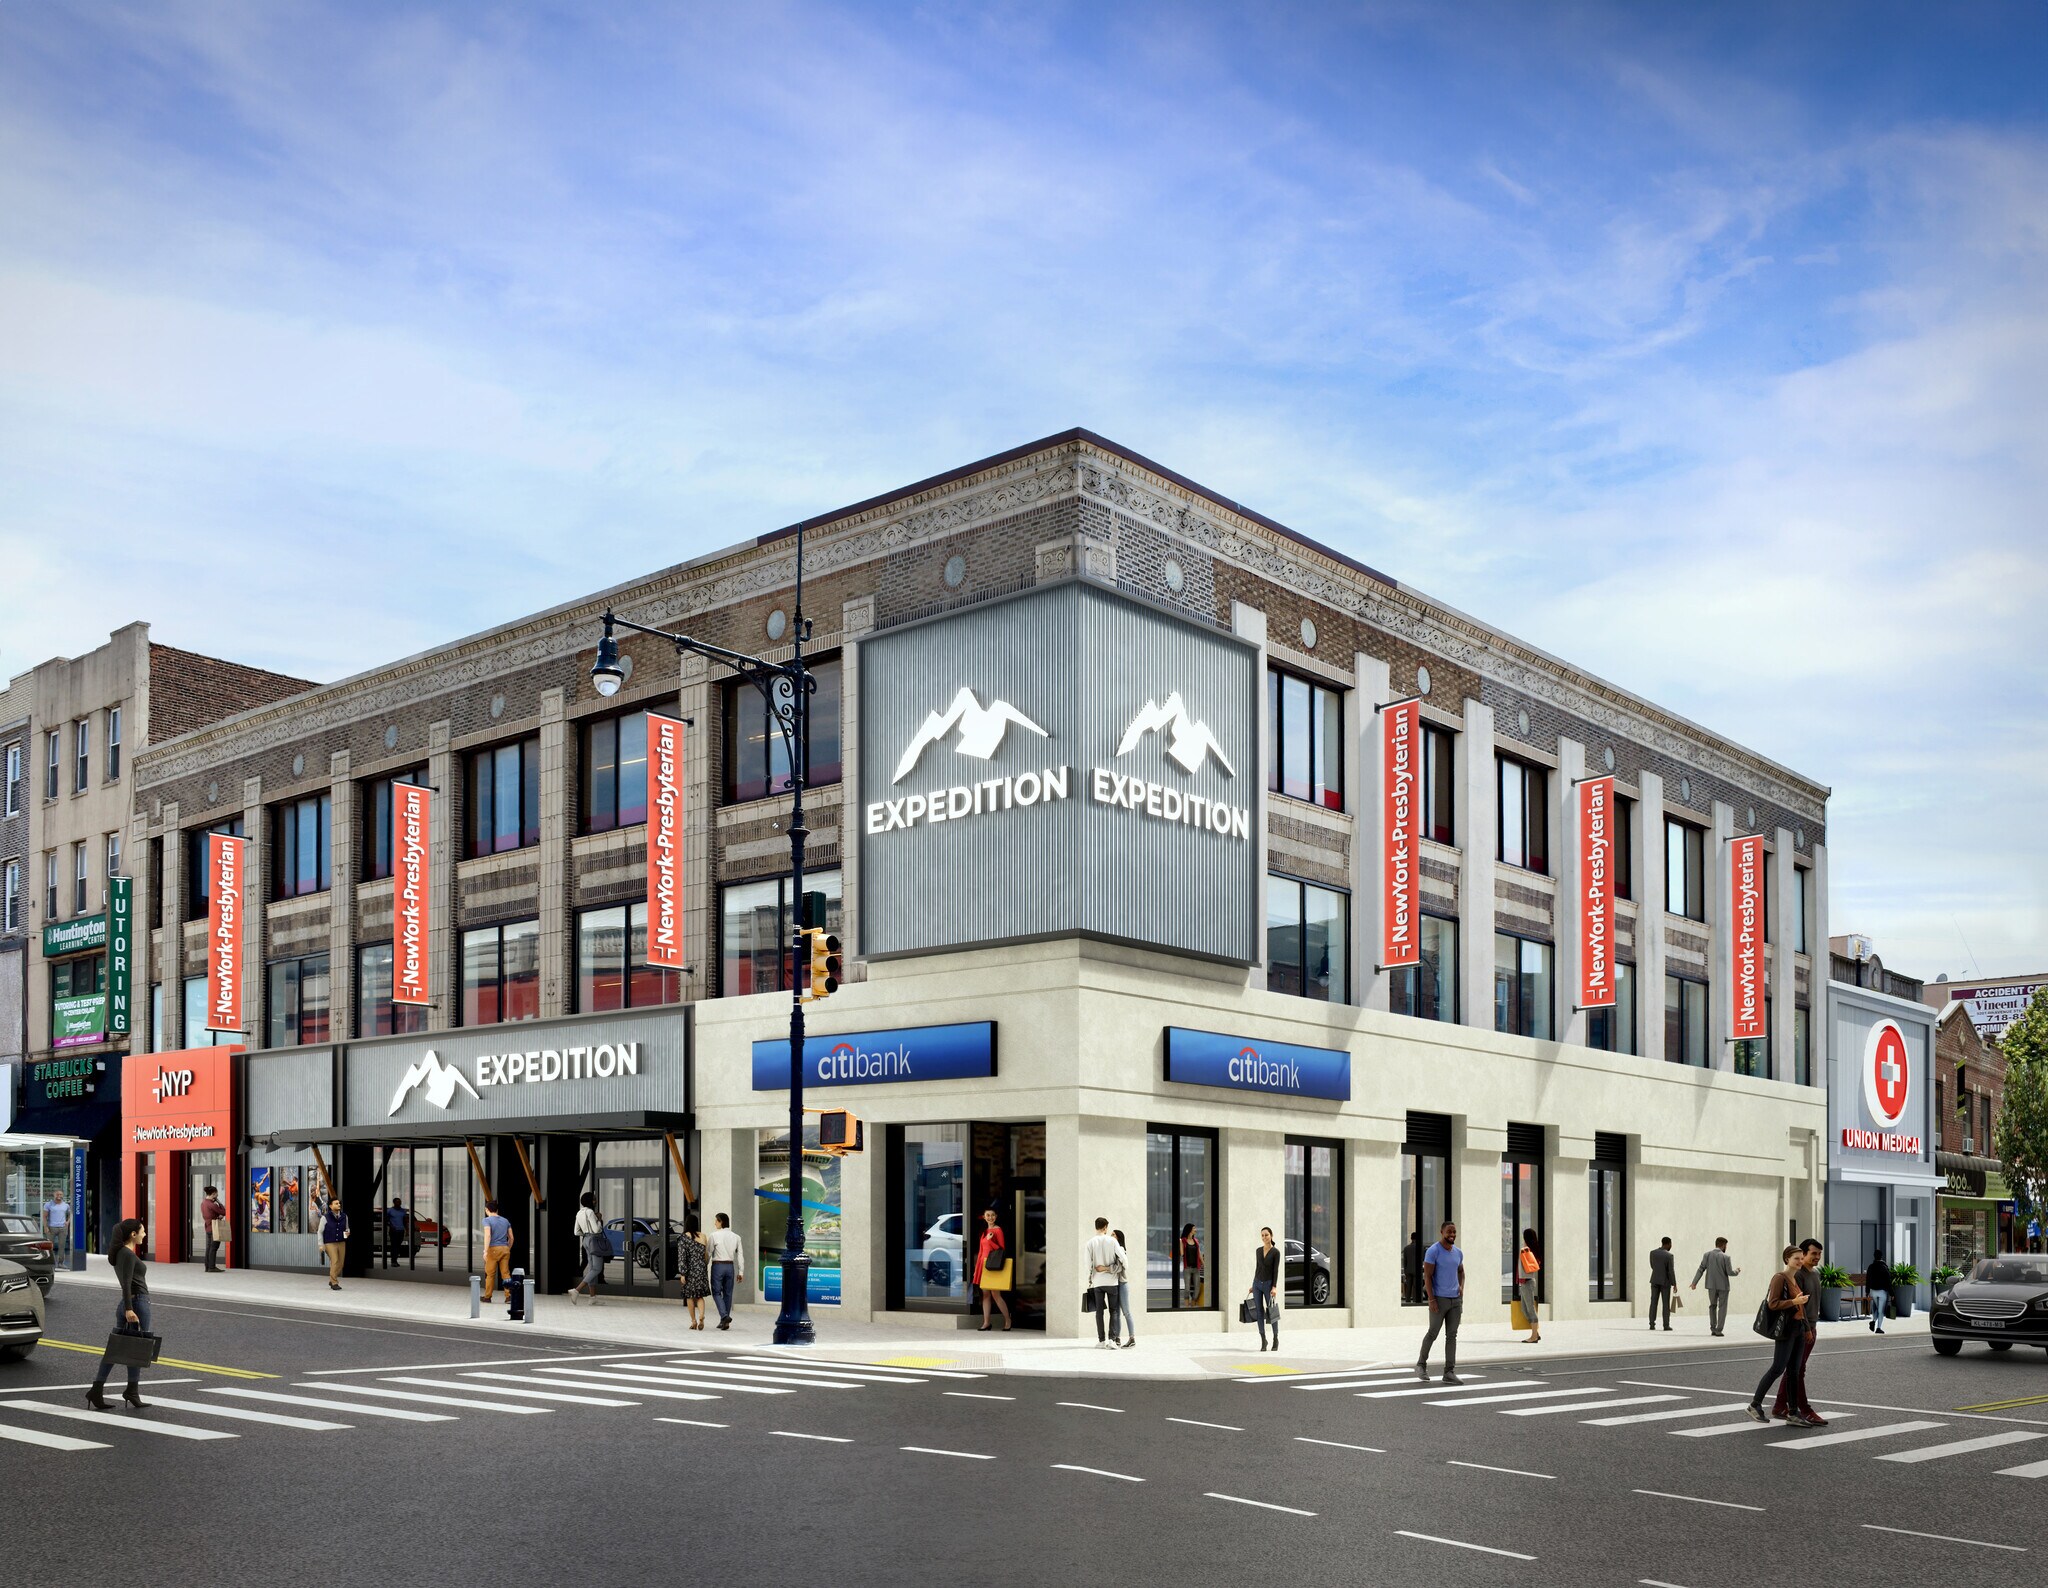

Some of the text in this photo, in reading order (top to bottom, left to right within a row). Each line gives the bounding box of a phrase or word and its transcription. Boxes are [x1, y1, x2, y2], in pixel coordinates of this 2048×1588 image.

[867, 765, 1070, 835] EXPEDITION
[1093, 767, 1250, 840] EXPEDITION
[656, 724, 679, 945] NewYork-Presbyterian
[1391, 708, 1413, 943] NewYork-Presbyterian
[402, 791, 425, 985] NewYork-Presbyterian
[1587, 783, 1609, 987] NewYork-Presbyterian
[53, 920, 106, 943] Huntington
[60, 933, 105, 951] LEARNING CENTER
[217, 841, 239, 1013] NewYork-Presbyterian
[1738, 841, 1759, 1021] NewYork-Presbyterian
[114, 879, 126, 1030] TUTORING
[1975, 987, 2025, 998] ACCIDENT
[1975, 1000, 2017, 1011] Vincent
[1975, 1023, 2007, 1033] CRIMIN
[1987, 1013, 2027, 1021] 718-85
[34, 1057, 93, 1081] STARBUCKS
[476, 1042, 640, 1087] EXPEDITION
[817, 1042, 912, 1080] citibank
[1228, 1050, 1300, 1089] citibank
[46, 1079, 83, 1099] COFFEE
[161, 1069, 193, 1098] NYP
[137, 1122, 214, 1142] NewYork-Presbyterian
[1845, 1128, 1924, 1155] UNION MEDICAL
